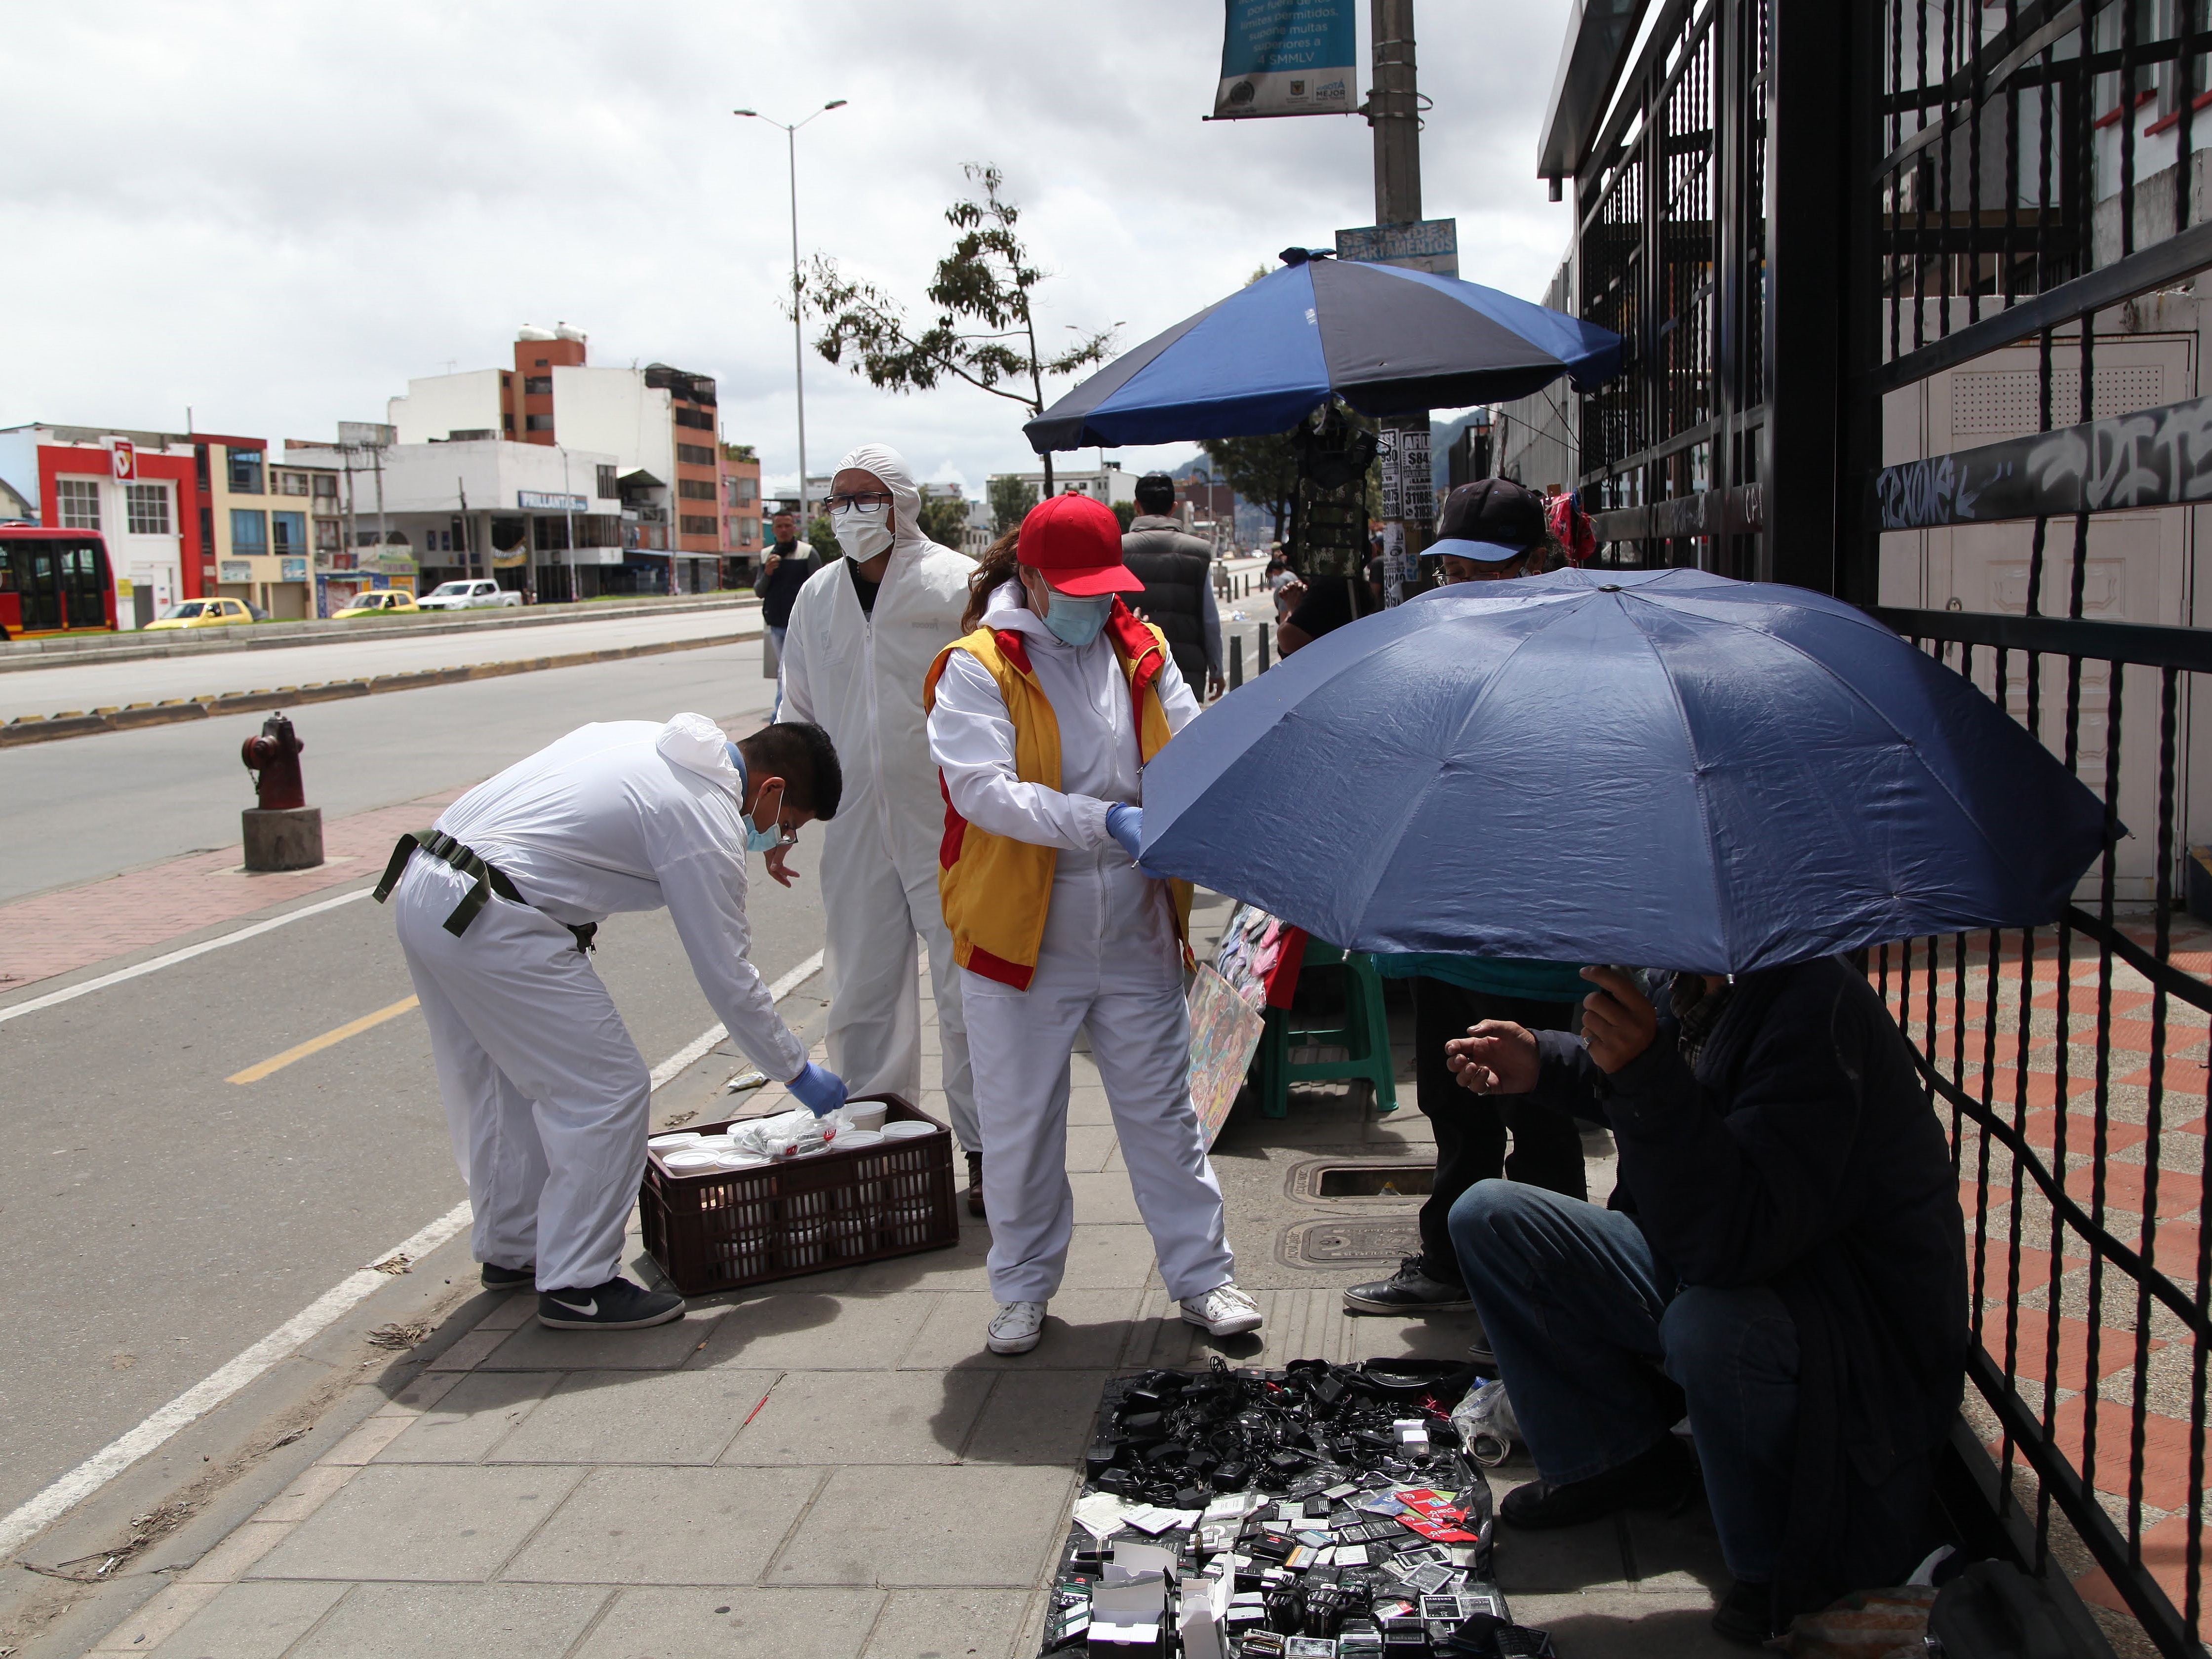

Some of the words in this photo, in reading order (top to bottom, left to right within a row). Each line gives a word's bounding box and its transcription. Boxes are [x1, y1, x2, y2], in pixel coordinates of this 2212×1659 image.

[1247, 4, 1265, 17] por
[1249, 26, 1286, 41] supone
[1290, 23, 1328, 35] multas
[1253, 39, 1311, 53] superiores
[1314, 38, 1321, 46] a
[1257, 54, 1265, 64] 4
[1269, 51, 1315, 65] SMMLV
[1340, 232, 1364, 247] SE
[1370, 222, 1454, 243] VENDEN
[1341, 237, 1455, 261] APARTAMENTOS
[1426, 1507, 1457, 1518] Claro
[1426, 1528, 1458, 1538] Claro
